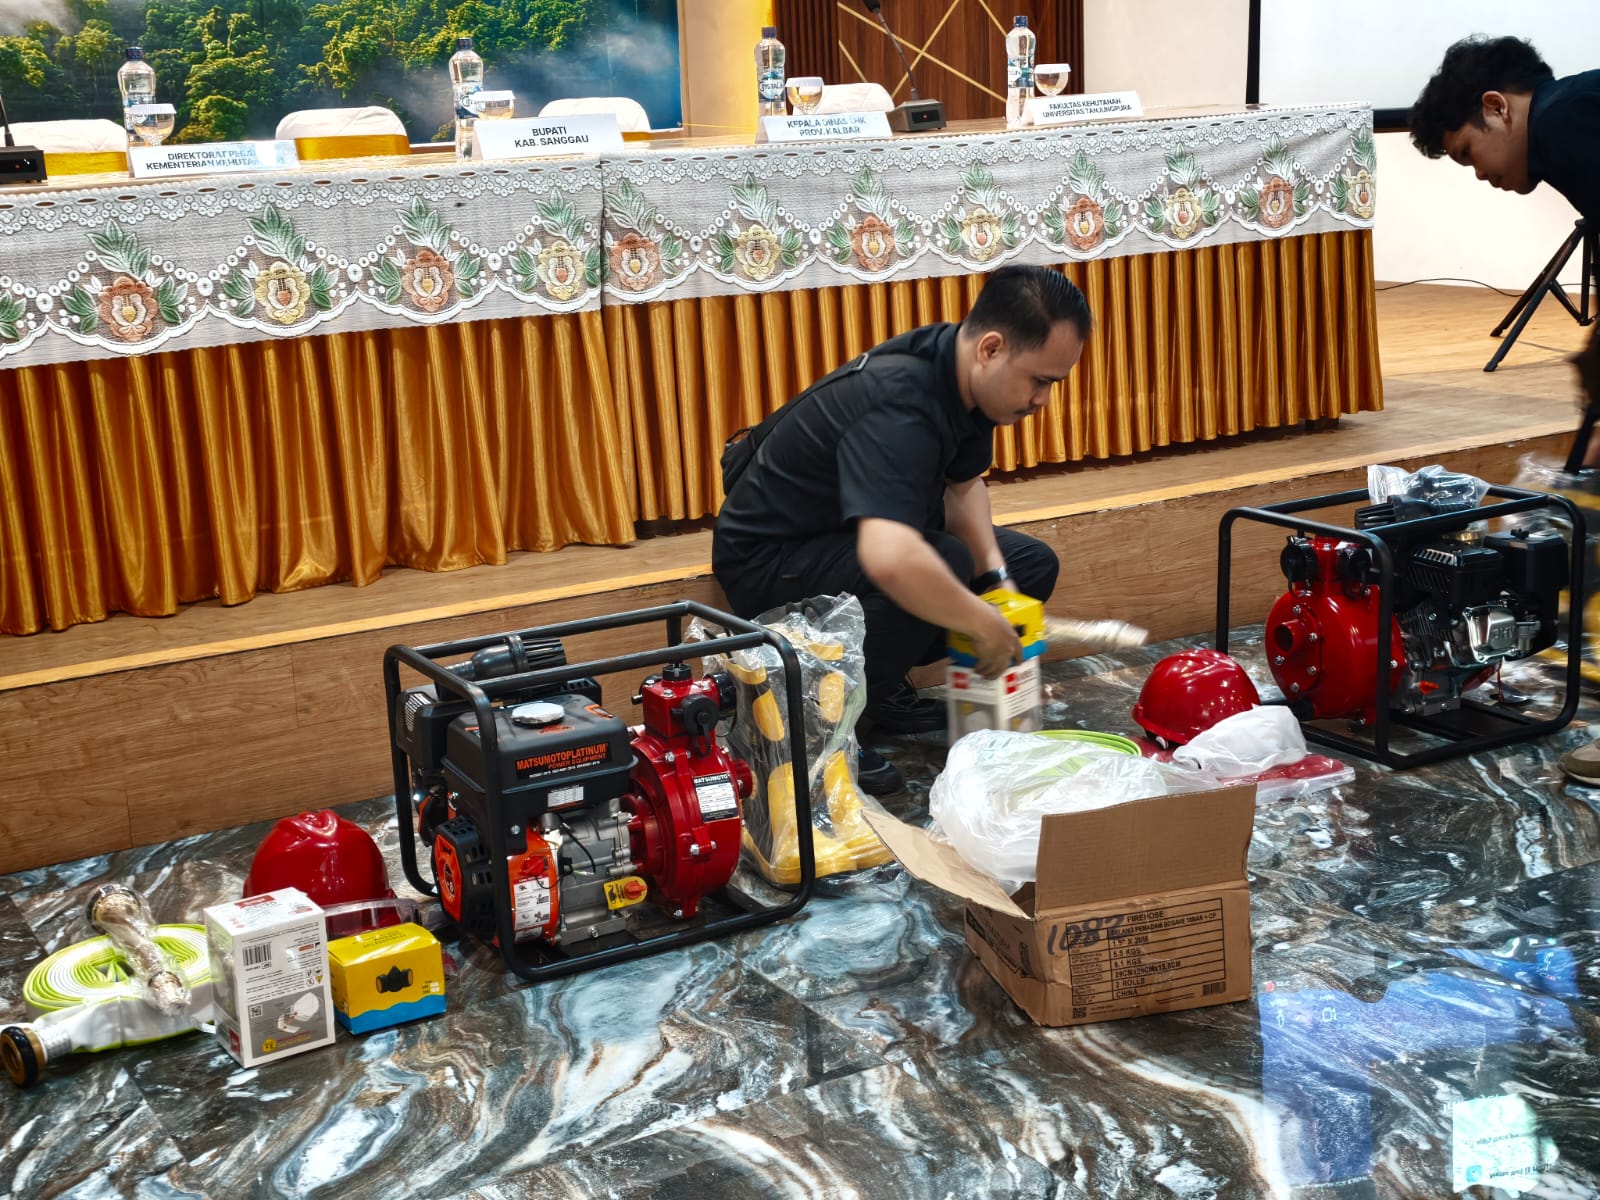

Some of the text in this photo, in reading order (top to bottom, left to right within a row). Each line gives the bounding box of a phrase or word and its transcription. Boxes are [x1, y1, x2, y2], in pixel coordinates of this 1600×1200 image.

[1048, 97, 1122, 110] FAKULTAS KEHUTANAN
[1042, 108, 1085, 118] UNIVERSITAS
[786, 118, 820, 129] KEPALA
[531, 125, 567, 137] BUPATI
[799, 126, 861, 137] PROV. KALBAR
[514, 134, 589, 148] KAB. SANGGAU
[167, 150, 227, 162] DIREKTORAT
[146, 156, 265, 171] KEMENTERIAN KEHUTA
[516, 743, 607, 771] MATSUMOTOPLATINUM
[571, 752, 607, 765] EQUIPMENT
[1127, 911, 1165, 923] FIREHOSE
[1135, 920, 1163, 933] PEMADAM
[1125, 947, 1142, 957] KGS
[1126, 958, 1142, 967] KGS
[1122, 977, 1146, 987] ROLLS
[1116, 989, 1138, 998] CHINA
